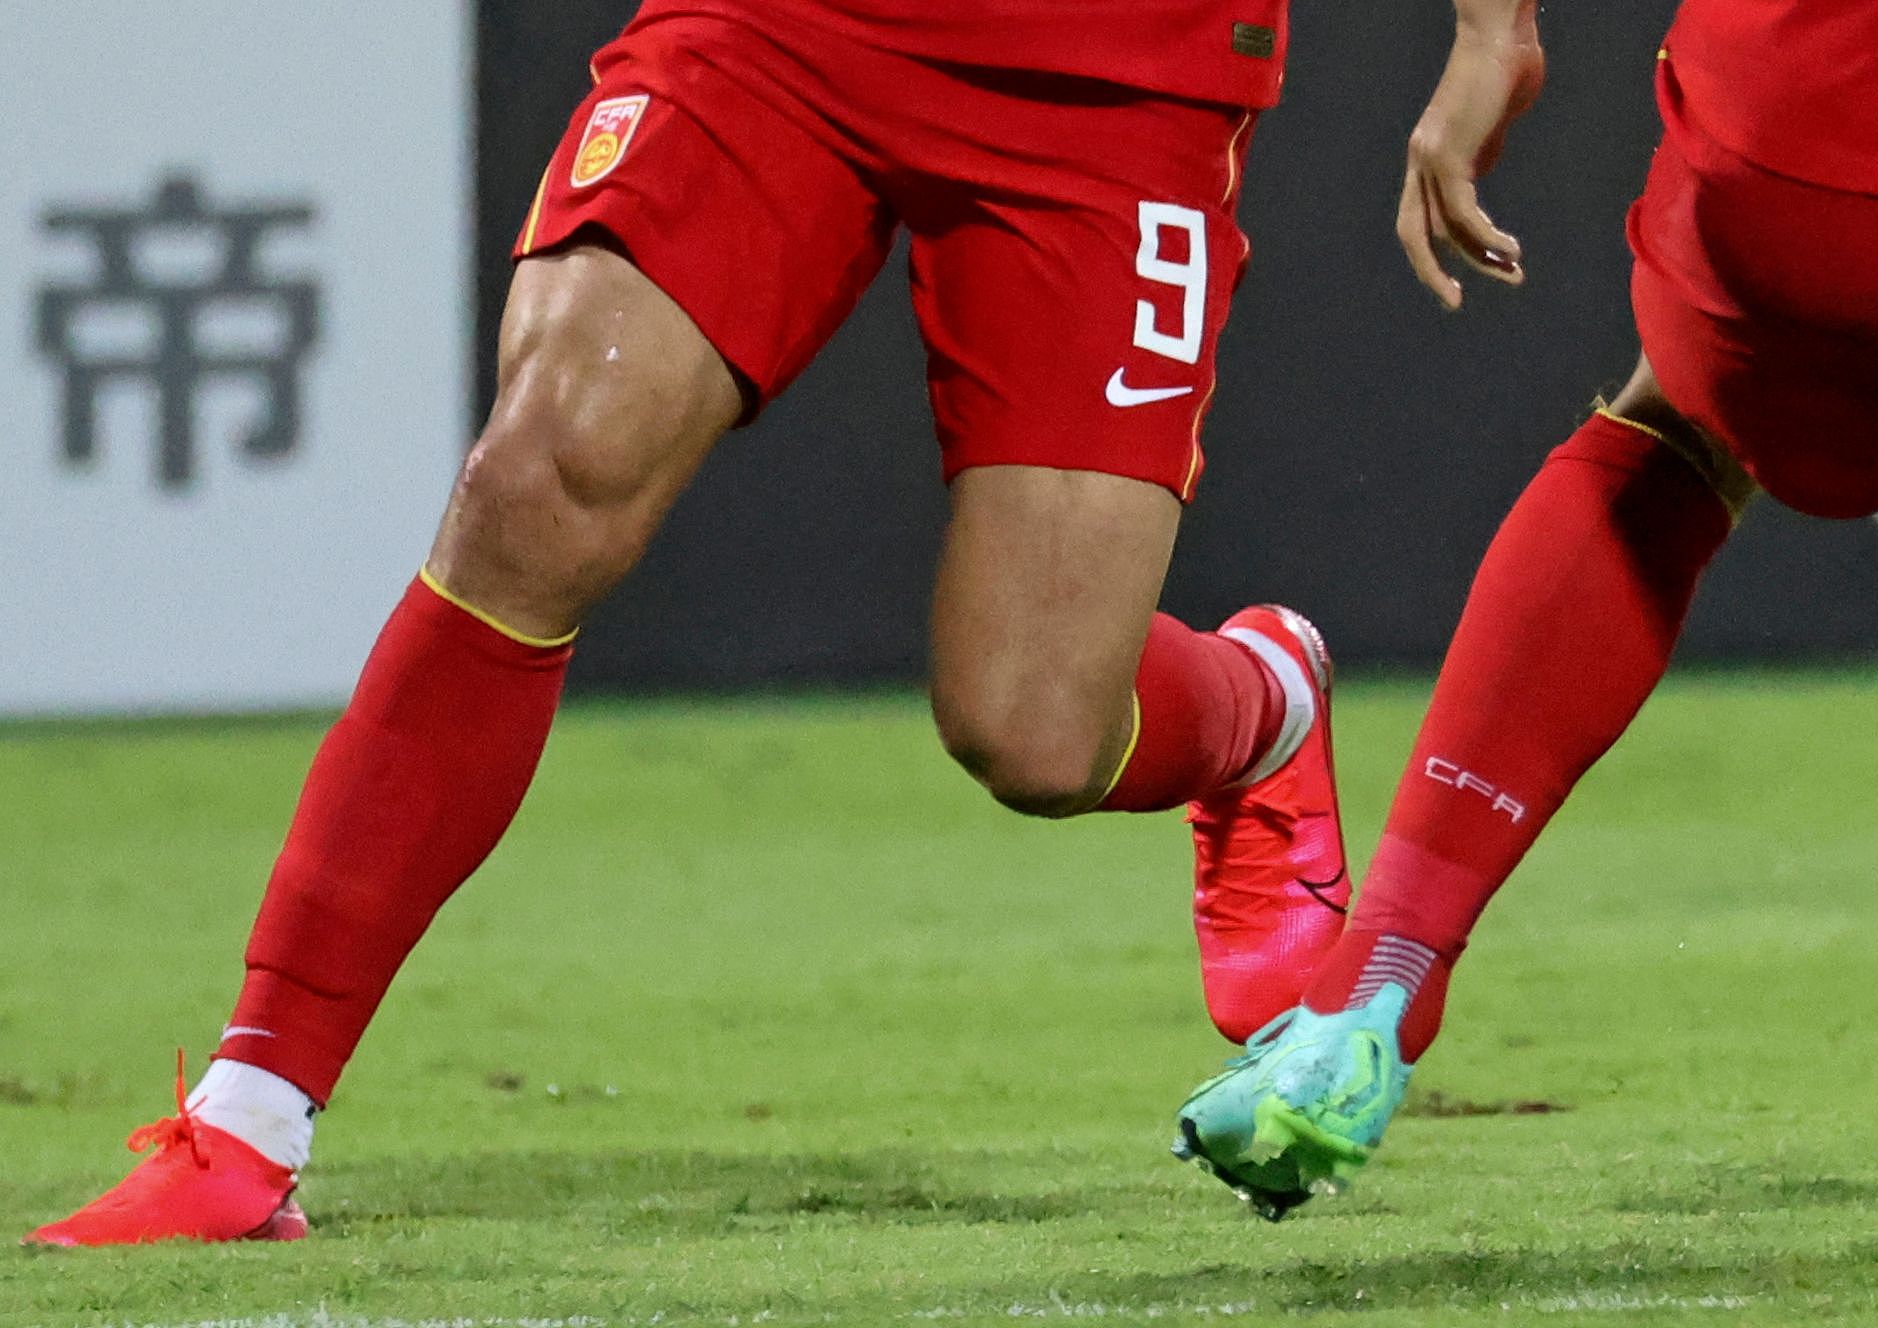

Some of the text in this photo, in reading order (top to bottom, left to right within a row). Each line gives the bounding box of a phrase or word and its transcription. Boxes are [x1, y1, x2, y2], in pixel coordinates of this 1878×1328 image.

[36, 174, 324, 490] 帝
[1133, 201, 1206, 364] 9
[1424, 756, 1525, 824] CFA
